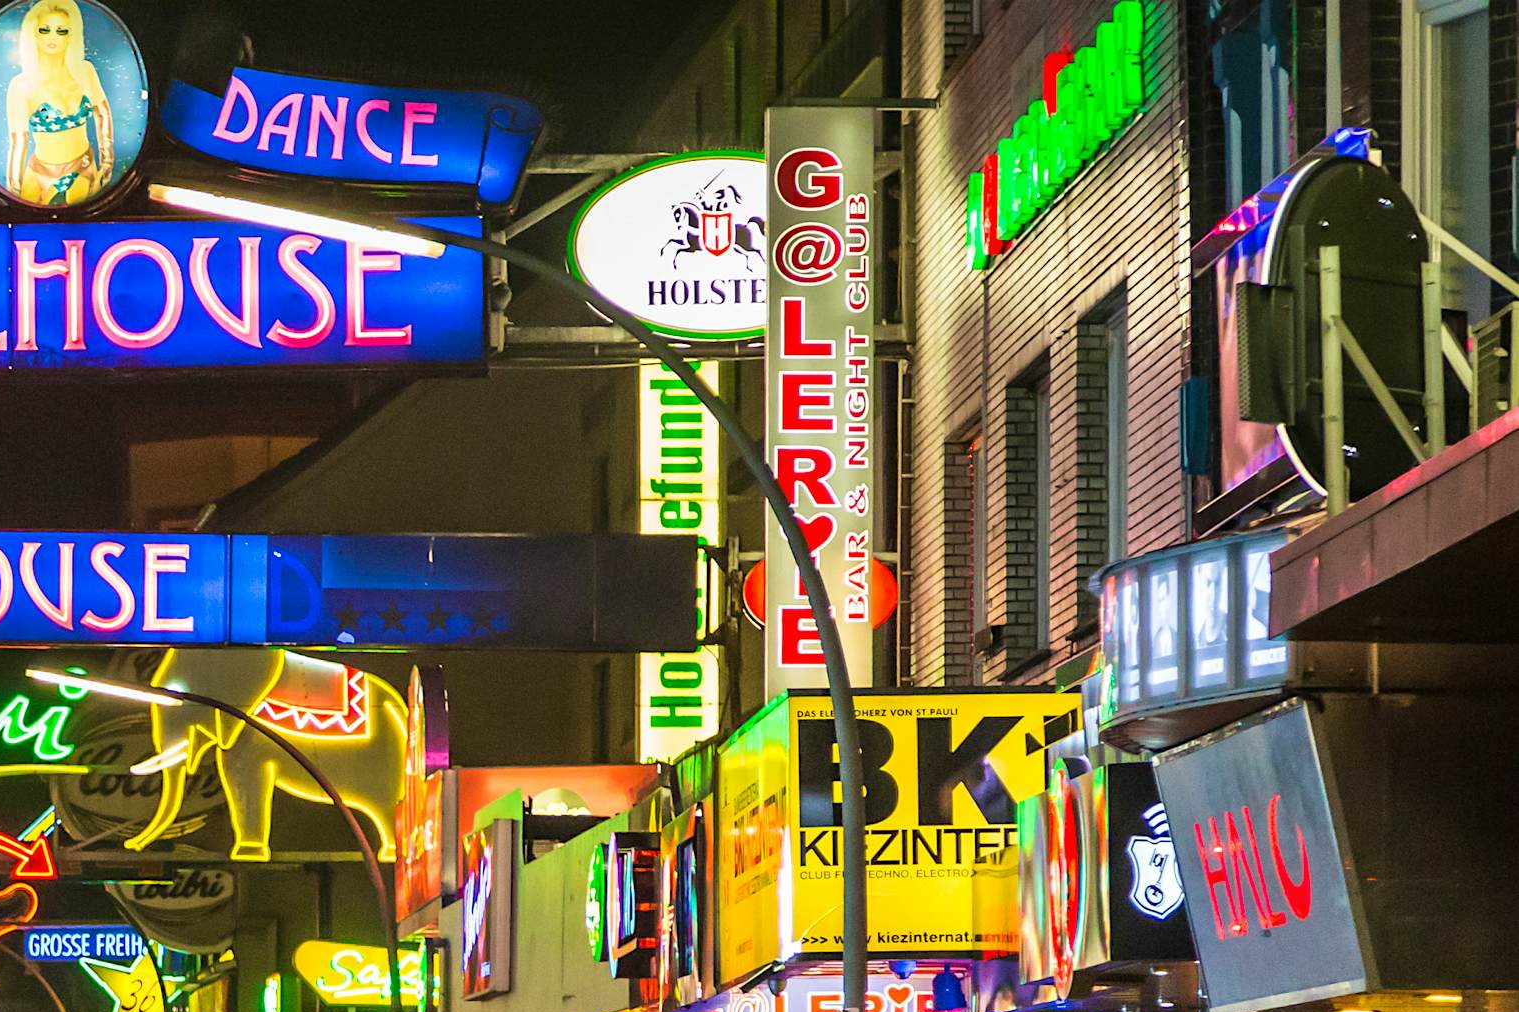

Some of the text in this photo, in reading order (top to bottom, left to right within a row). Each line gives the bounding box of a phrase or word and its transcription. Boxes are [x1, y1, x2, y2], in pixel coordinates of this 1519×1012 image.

[212, 75, 439, 166] DANCE
[648, 279, 766, 305] HOLSTE
[845, 193, 870, 623] BAR & NIGHT CLUB
[797, 710, 816, 718] DAS
[819, 709, 887, 718] ELEOHERZ
[890, 709, 913, 717] VON
[800, 871, 831, 880] CLUB
[868, 868, 913, 879] ECHNO,
[28, 933, 143, 958] GROSSE FREIH
[877, 932, 973, 944] kiezinternat.
